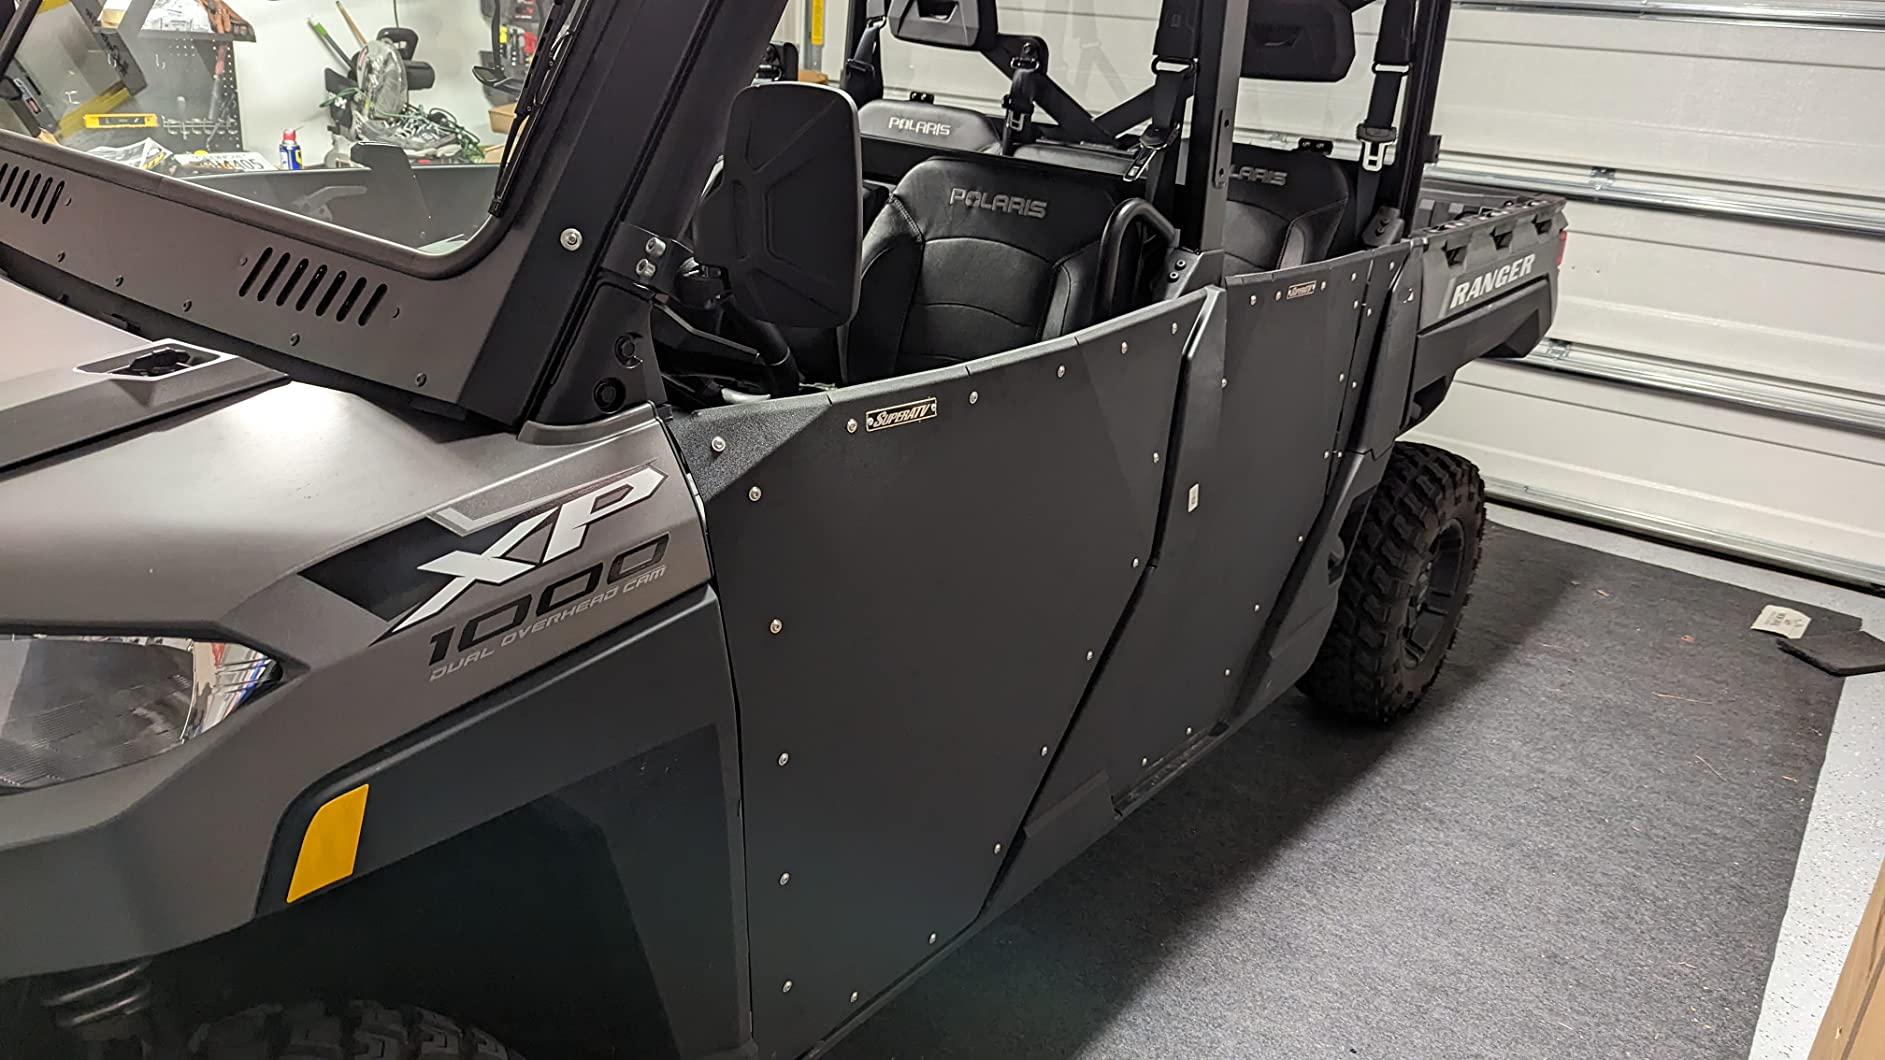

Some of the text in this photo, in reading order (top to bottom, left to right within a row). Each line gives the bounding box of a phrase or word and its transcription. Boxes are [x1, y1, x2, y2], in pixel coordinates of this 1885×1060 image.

[888, 117, 952, 136] POLARIS
[1230, 164, 1288, 186] LARIS
[950, 188, 1048, 219] POLARIS
[1449, 253, 1536, 309] RANGER
[390, 467, 666, 633] XP
[428, 532, 670, 666] 1000
[429, 565, 668, 682] DUAL OVERHEAD CAM
